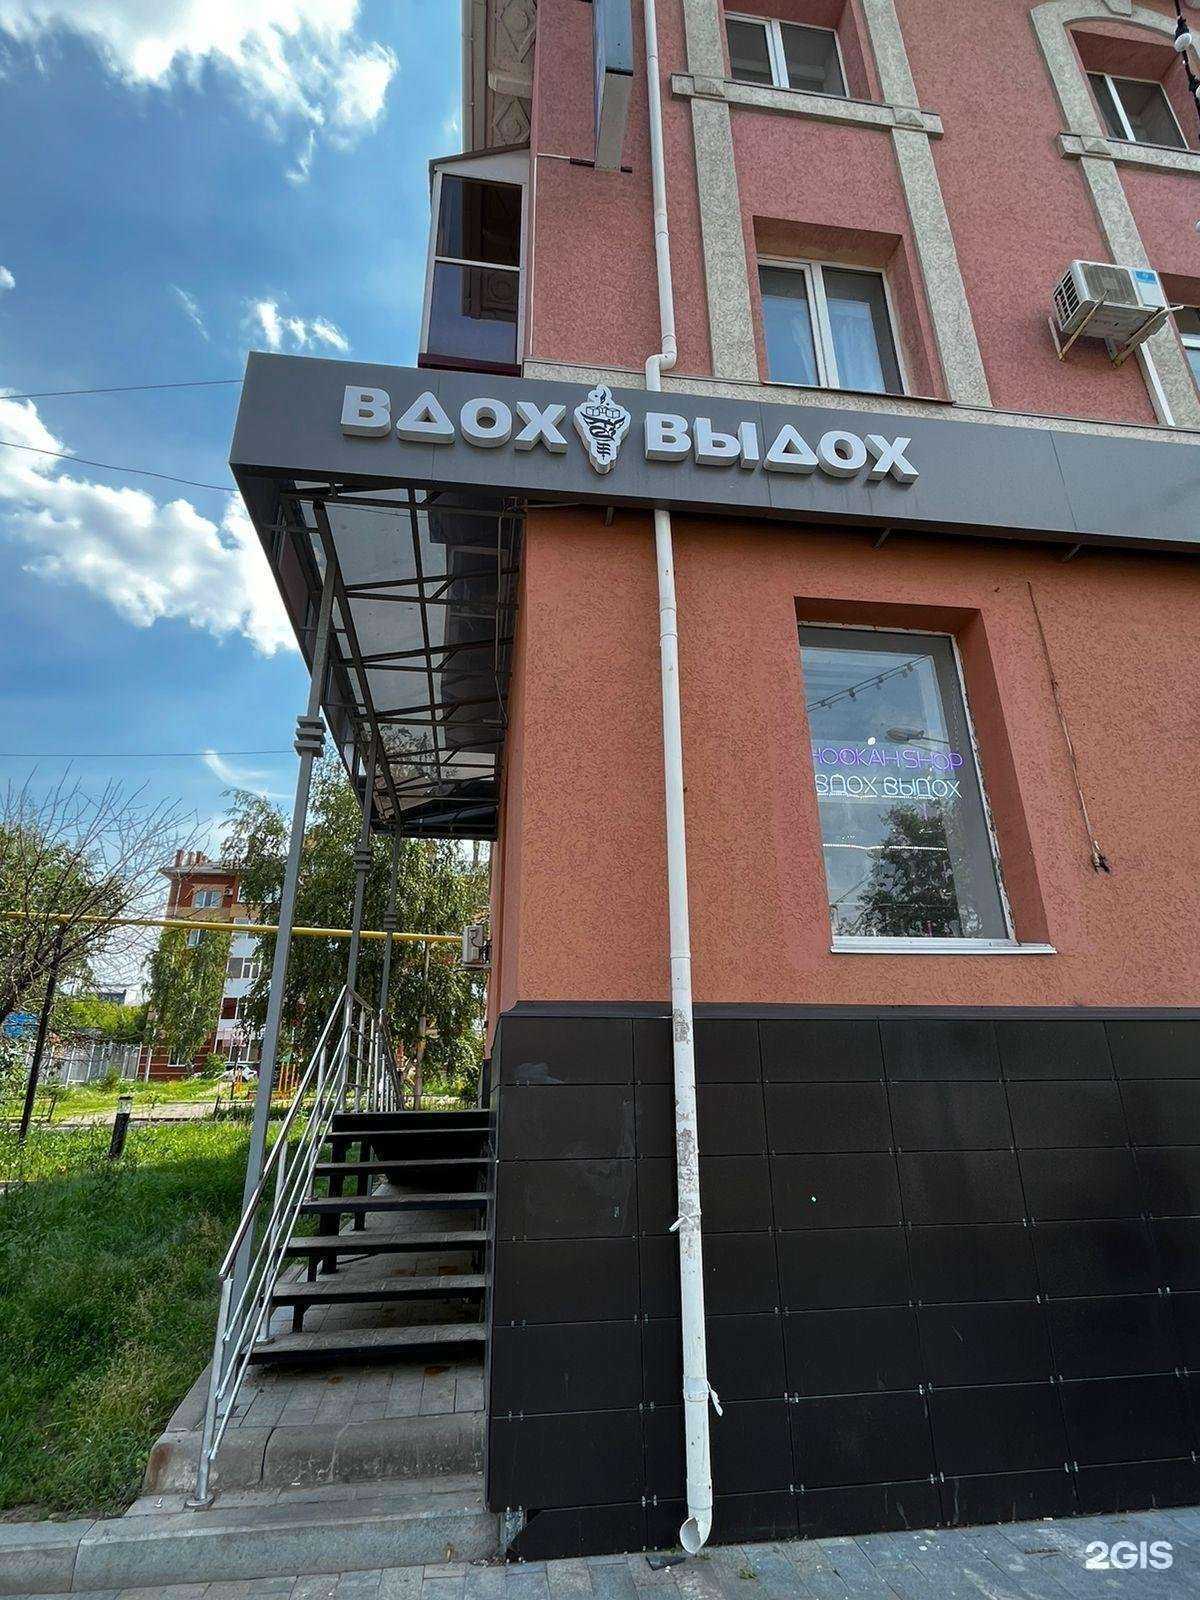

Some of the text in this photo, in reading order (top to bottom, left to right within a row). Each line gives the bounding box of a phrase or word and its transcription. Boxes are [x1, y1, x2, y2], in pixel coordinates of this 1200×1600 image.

[341, 385, 919, 482] ВДОХ ВЫДОХ
[902, 749, 963, 771] SHOP
[815, 774, 963, 800] ВДОХ ВЫДОХ
